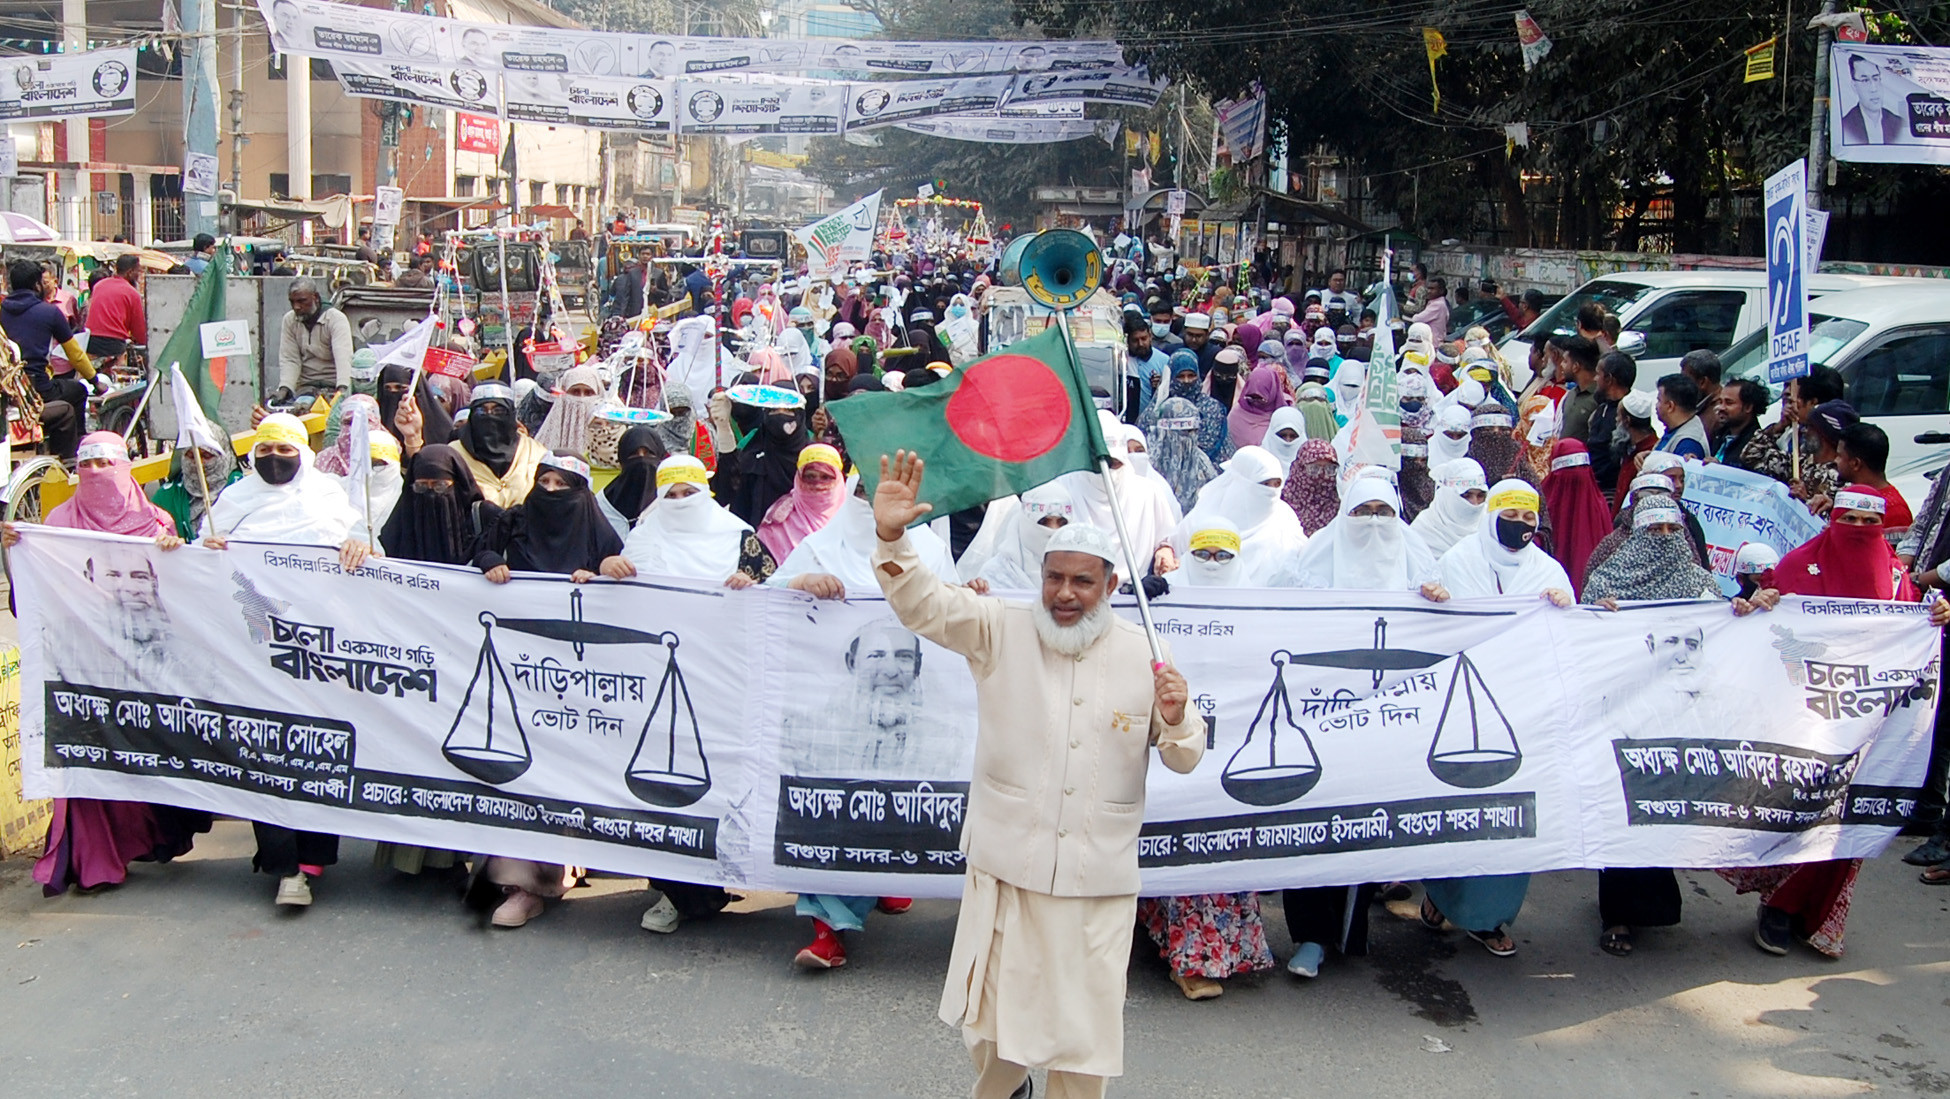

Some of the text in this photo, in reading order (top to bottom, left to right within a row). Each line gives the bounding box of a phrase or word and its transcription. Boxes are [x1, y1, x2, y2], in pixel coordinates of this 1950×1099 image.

[21, 87, 77, 101] বাংলাদেশ
[568, 94, 619, 107] বাংলাদেশ
[569, 86, 589, 95] চলো
[1911, 102, 1944, 117] তারেক
[1773, 331, 1800, 358] DEAF
[264, 551, 342, 576] বিসমিল্লাহির
[406, 573, 440, 591] রহিম
[1802, 600, 1881, 616] বিসমিল্লাহির
[267, 614, 435, 668] চলো একসাথে গড়ি
[1153, 618, 1235, 637] মানির রহিম
[268, 643, 438, 703] বাংলাদেশ
[510, 653, 647, 705] দাঁড়িপাল্লায়
[1804, 659, 1871, 689] চলো
[53, 690, 351, 760] অধ্যক্ষ মোঃ আবিদুর রহমান সোহেল
[531, 706, 625, 737] ভোট দিন
[1319, 703, 1421, 733] ভোট দিন
[54, 743, 109, 764] বগুড়া
[115, 750, 185, 771] সদর-৬
[192, 759, 244, 781] সংসদ
[250, 770, 298, 794] সদস্য
[1622, 747, 1678, 776] অধ্যক্ষ
[1684, 747, 1718, 777] মোঃ
[1719, 740, 1779, 789] আবিদুর
[1779, 754, 1827, 788] রহমান
[362, 782, 408, 805] প্রচারে:
[412, 787, 474, 813] বাংলাদেশ
[476, 794, 538, 822] জামায়াতে
[593, 815, 632, 840] বগুড়া
[634, 820, 664, 842] শহর
[667, 824, 705, 851] শাখা।
[787, 781, 966, 832] অধ্যক্ষ মোঃ আবিদুর
[1636, 799, 1687, 822] বগুড়া
[1694, 803, 1750, 821] সদর-৬
[1755, 806, 1793, 824] সংসদ
[1852, 796, 1892, 817] প্রচারে:
[1138, 805, 1525, 857] চারে: বাংলাদেশ জামায়াতে ইসলামী, বগুড়া শহর শাখা।
[784, 840, 840, 865] বগুড়া
[844, 846, 919, 866] সদর-৬
